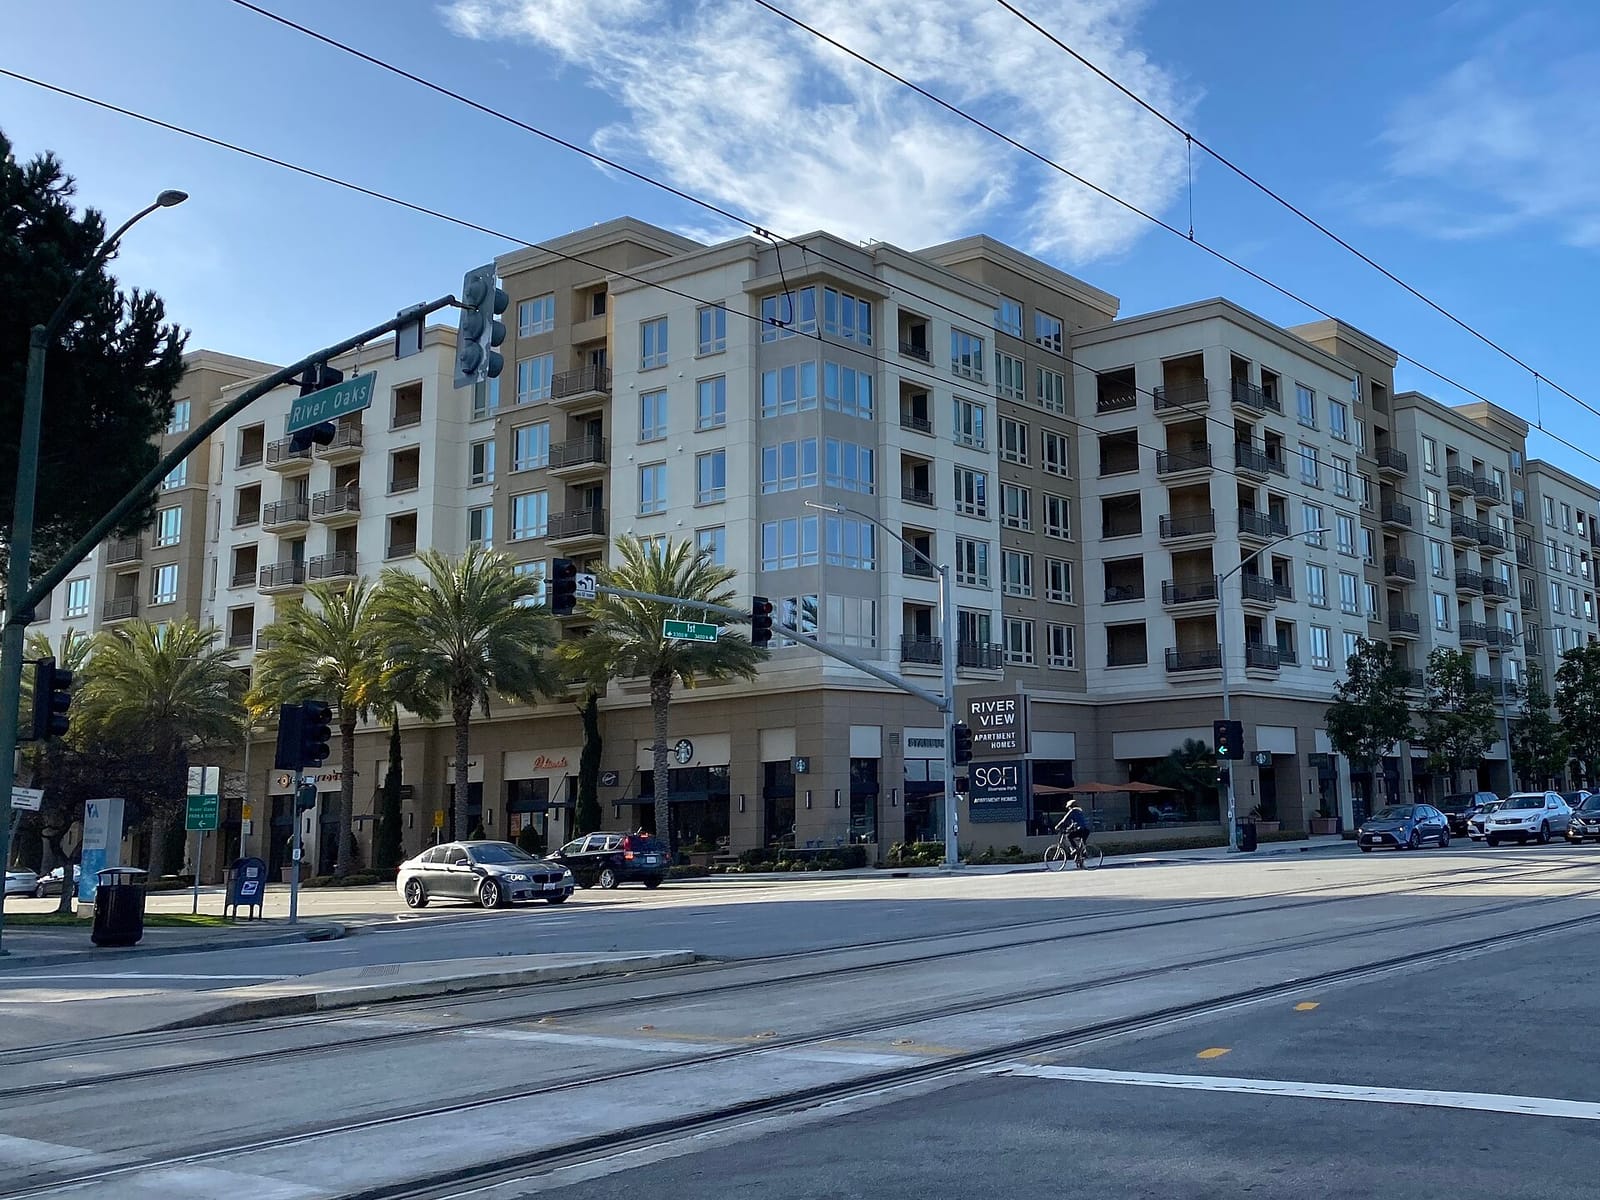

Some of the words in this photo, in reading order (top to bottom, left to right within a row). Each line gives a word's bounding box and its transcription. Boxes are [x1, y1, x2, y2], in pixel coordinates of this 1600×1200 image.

[292, 400, 327, 423] River
[334, 386, 367, 409] Oaks
[971, 700, 1015, 714] RIVER
[980, 713, 1015, 726] VIEW
[974, 732, 1016, 742] APARTMENT
[991, 740, 1016, 749] HOMES
[975, 766, 1017, 787] SOFI
